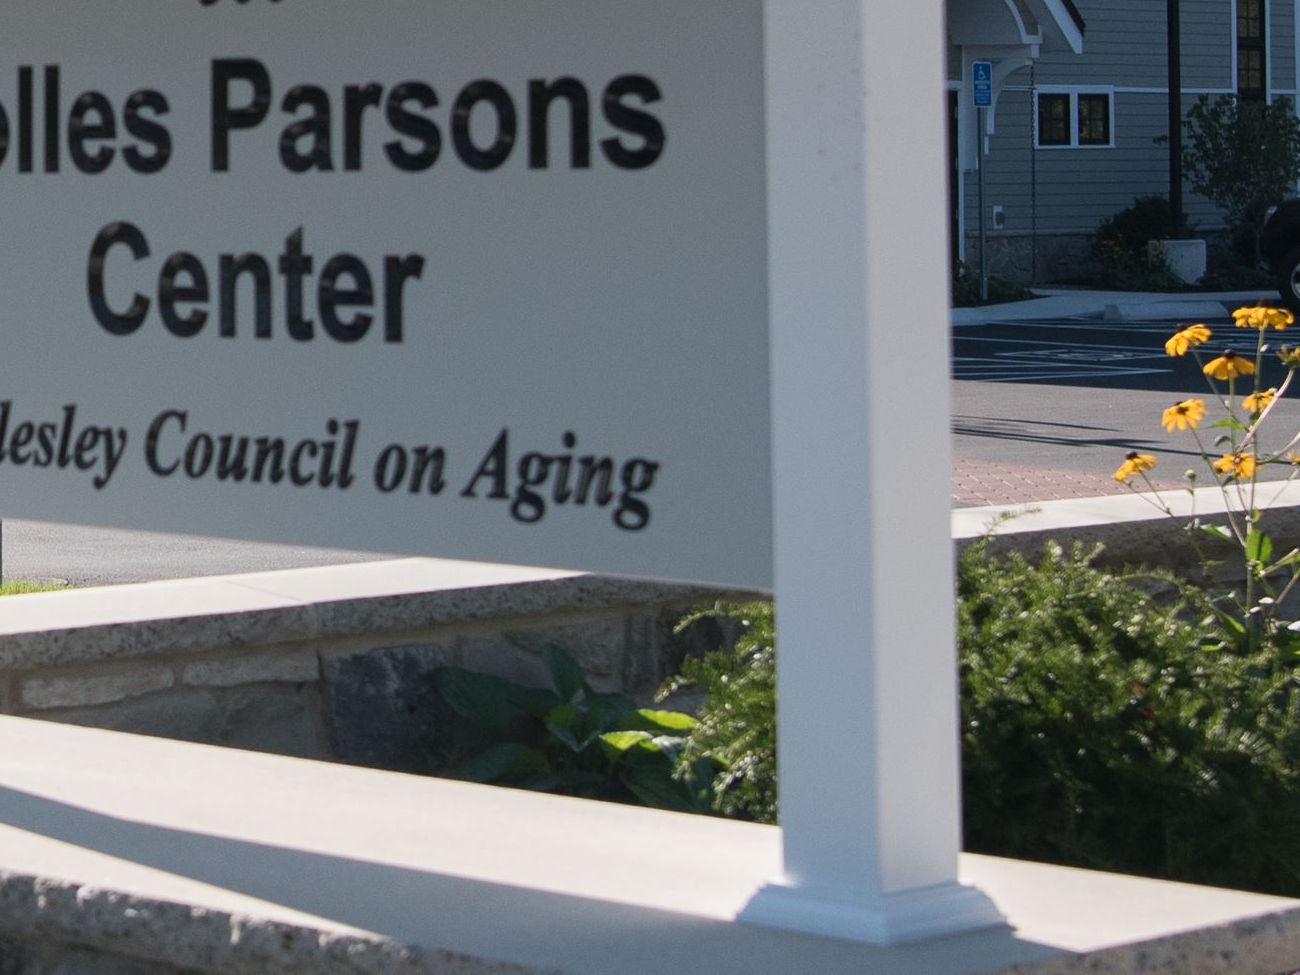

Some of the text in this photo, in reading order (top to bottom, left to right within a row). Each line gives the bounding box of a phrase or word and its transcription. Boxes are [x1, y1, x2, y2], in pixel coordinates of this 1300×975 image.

[210, 57, 667, 174] Parsons
[87, 220, 426, 344] Center
[144, 408, 361, 492] Council
[374, 442, 448, 497] on
[459, 426, 661, 533] Aging
